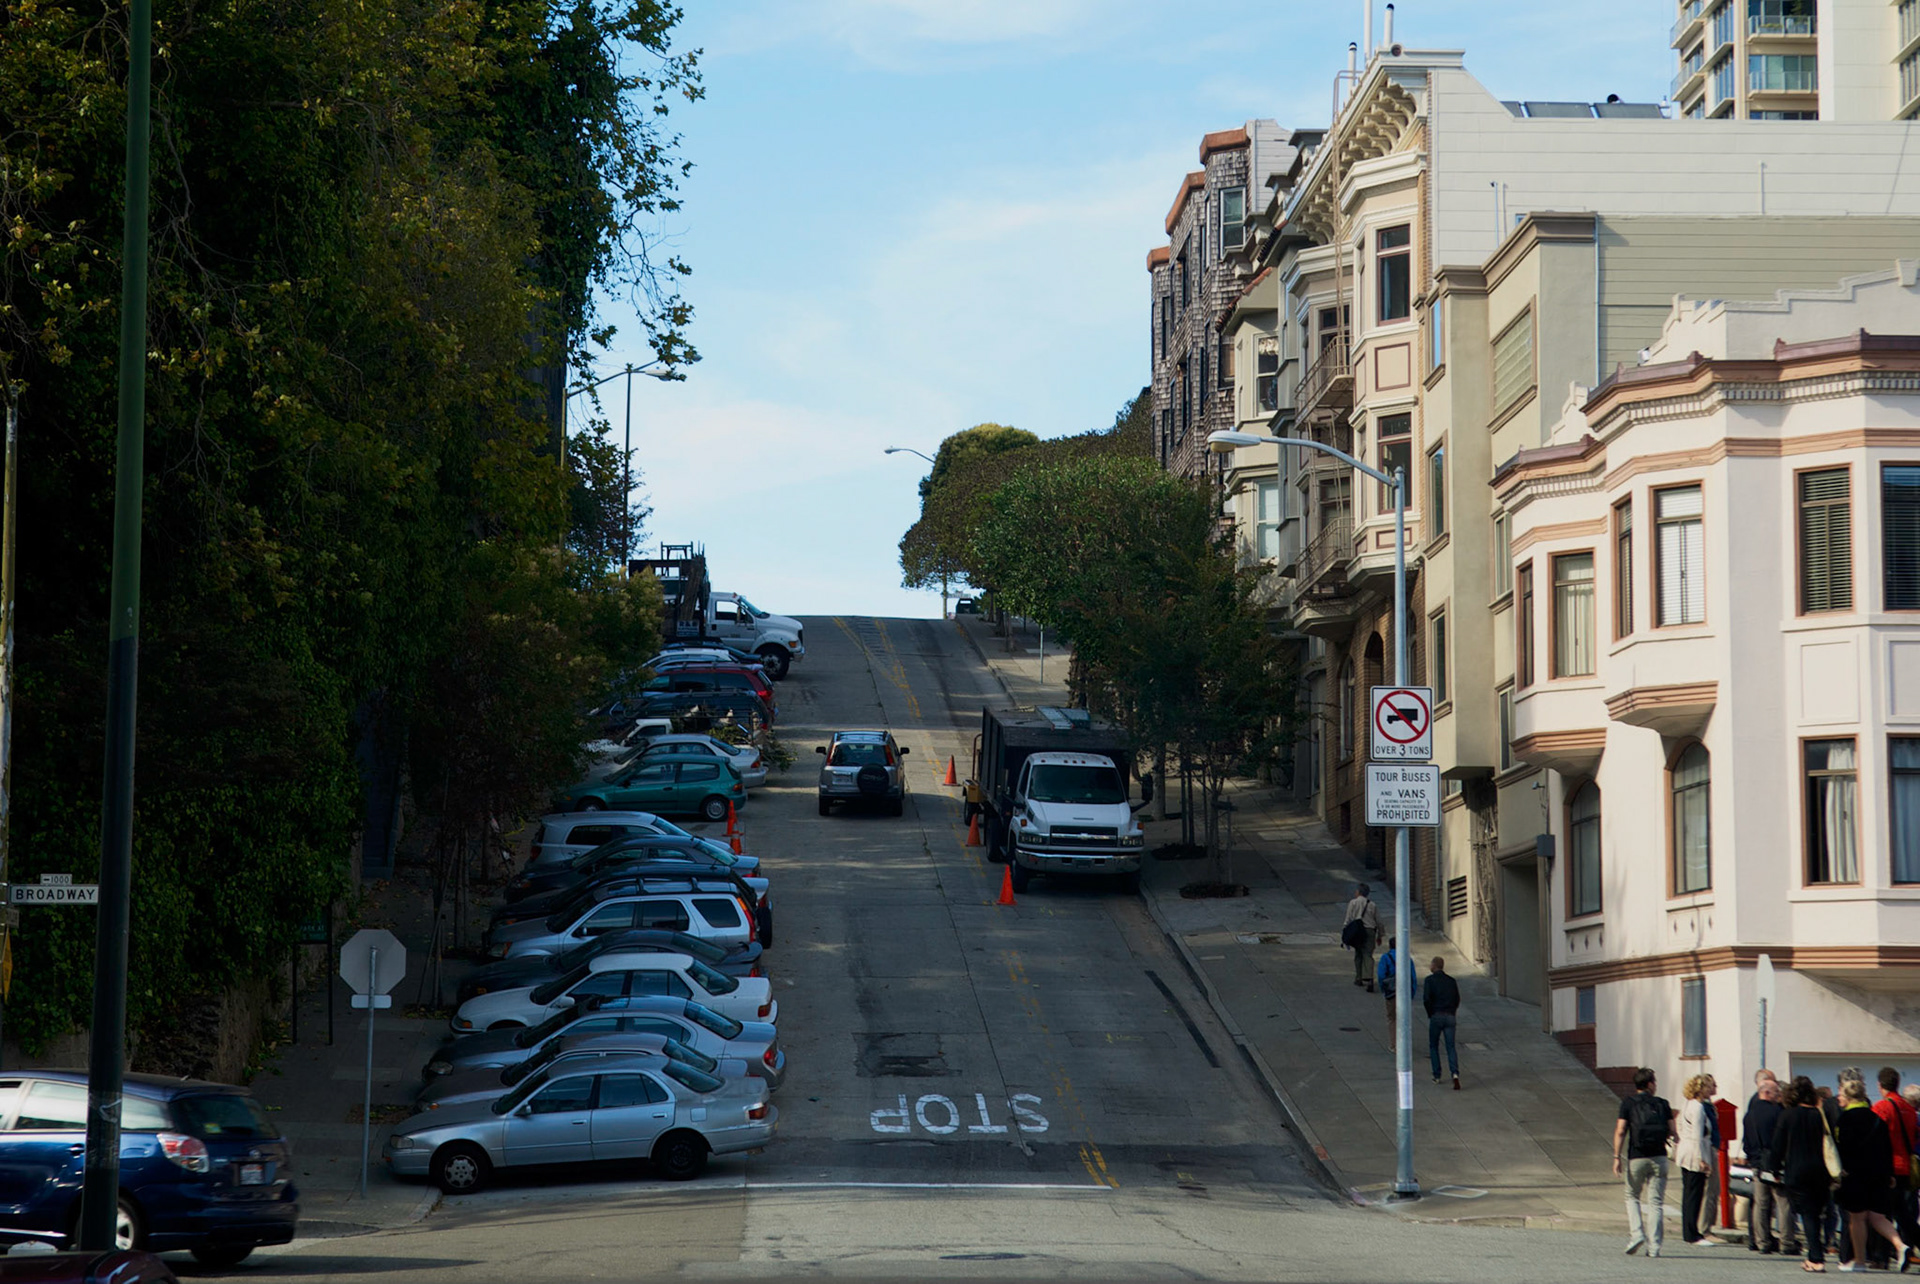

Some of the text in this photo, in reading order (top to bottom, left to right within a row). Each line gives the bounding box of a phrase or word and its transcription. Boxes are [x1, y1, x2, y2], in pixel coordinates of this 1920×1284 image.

[1375, 744, 1430, 756] OVER 3 TONS
[1375, 772, 1431, 782] TOUR BUSES
[1398, 789, 1426, 798] VANS
[1376, 810, 1430, 820] PROHIBITED
[16, 889, 95, 900] BROADWAY
[870, 1093, 1050, 1134] STOP
